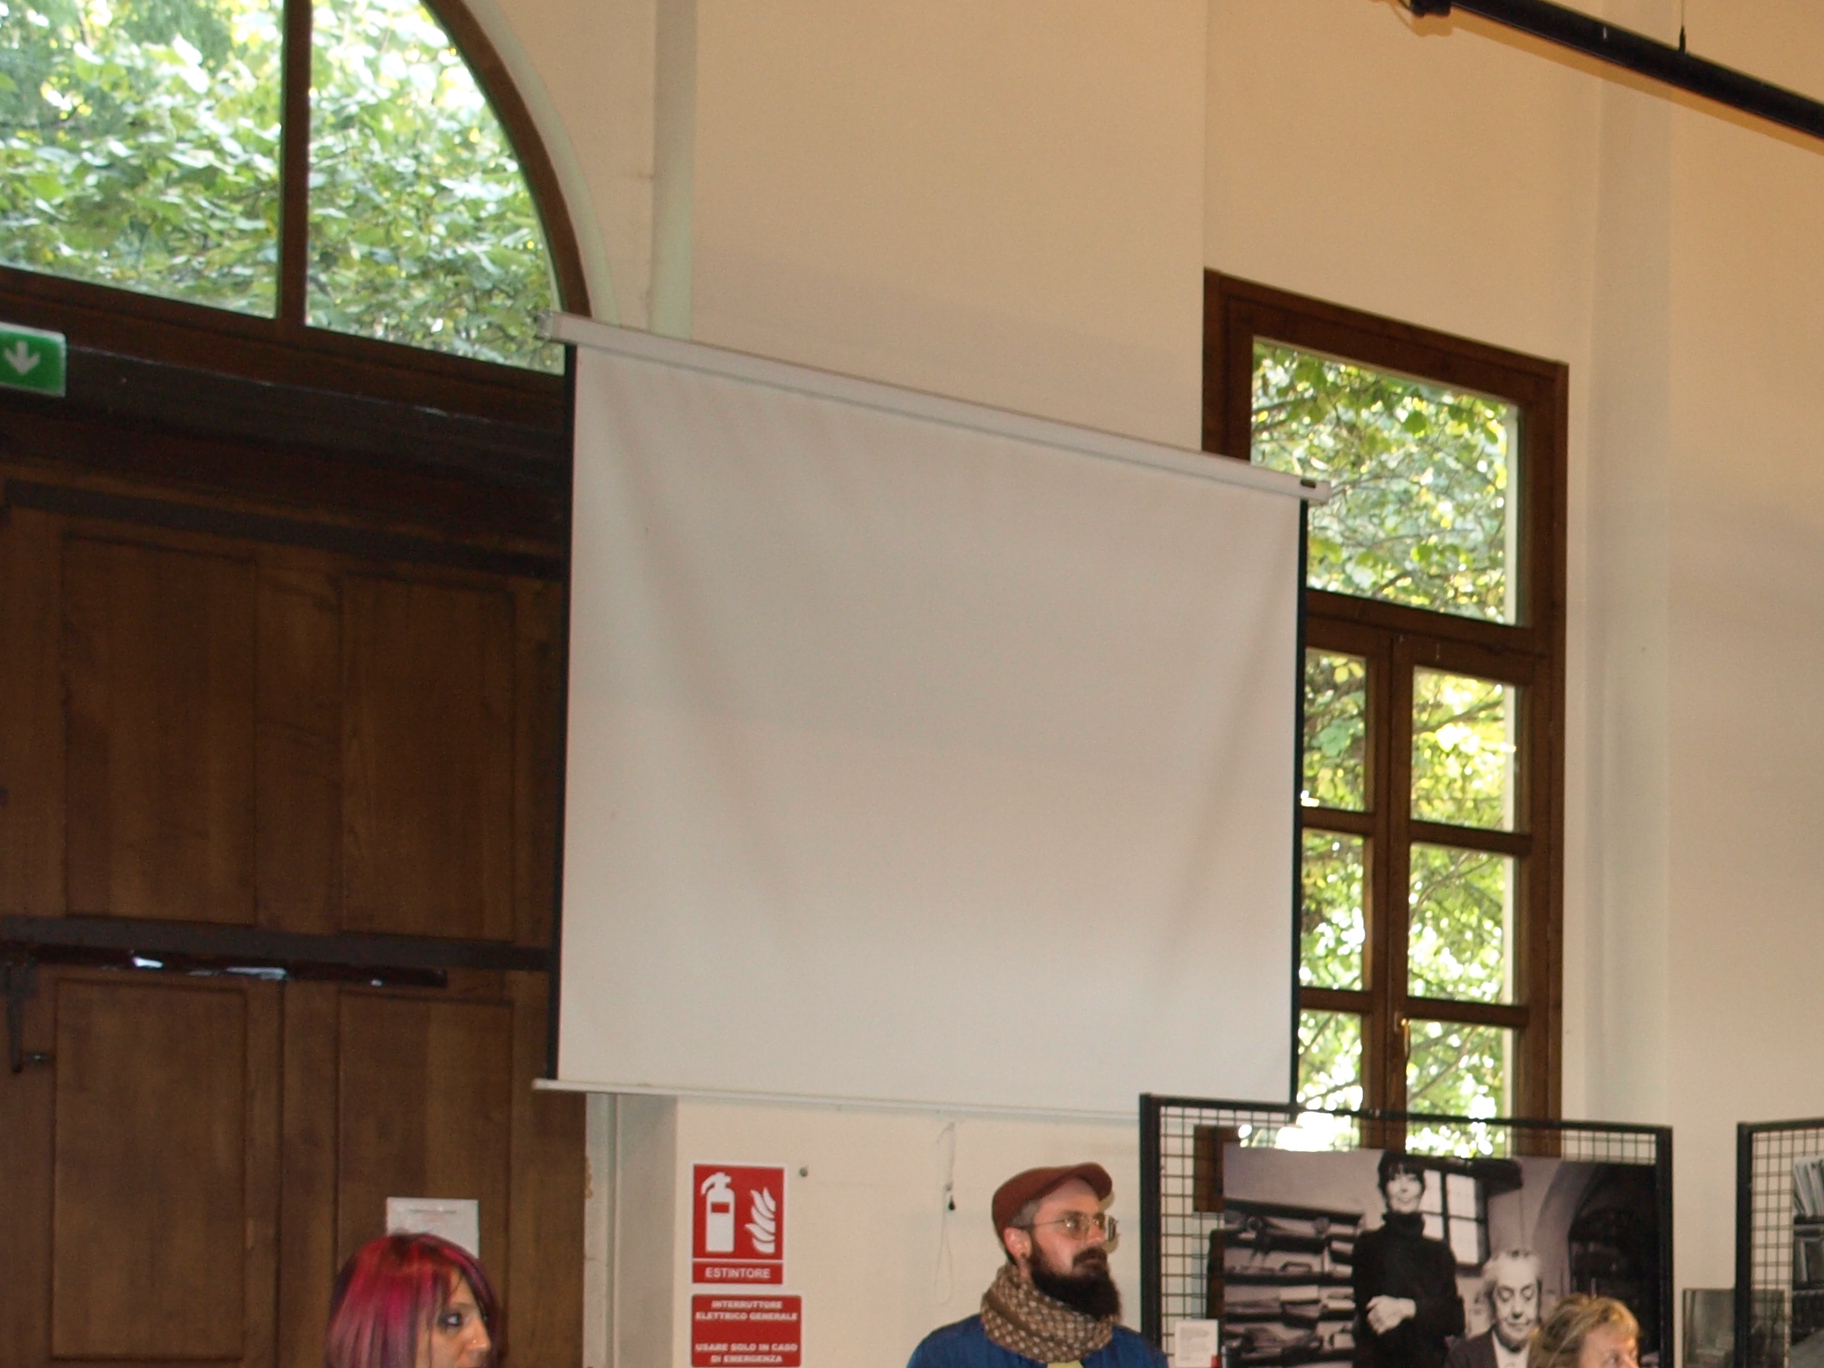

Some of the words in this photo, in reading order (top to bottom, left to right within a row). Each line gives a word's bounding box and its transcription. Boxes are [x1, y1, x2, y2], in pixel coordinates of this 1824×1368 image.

[705, 1267, 771, 1279] ESTINTORE
[711, 1300, 783, 1309] INTERRUTTORE
[695, 1311, 748, 1320] ELETTRICO
[749, 1312, 798, 1321] GENERALE
[695, 1343, 728, 1351] USARE
[730, 1343, 756, 1351] SOLO
[758, 1343, 769, 1351] IN
[771, 1343, 798, 1352] CASO
[710, 1354, 721, 1363] DI
[723, 1354, 783, 1364] EMERGENZA
